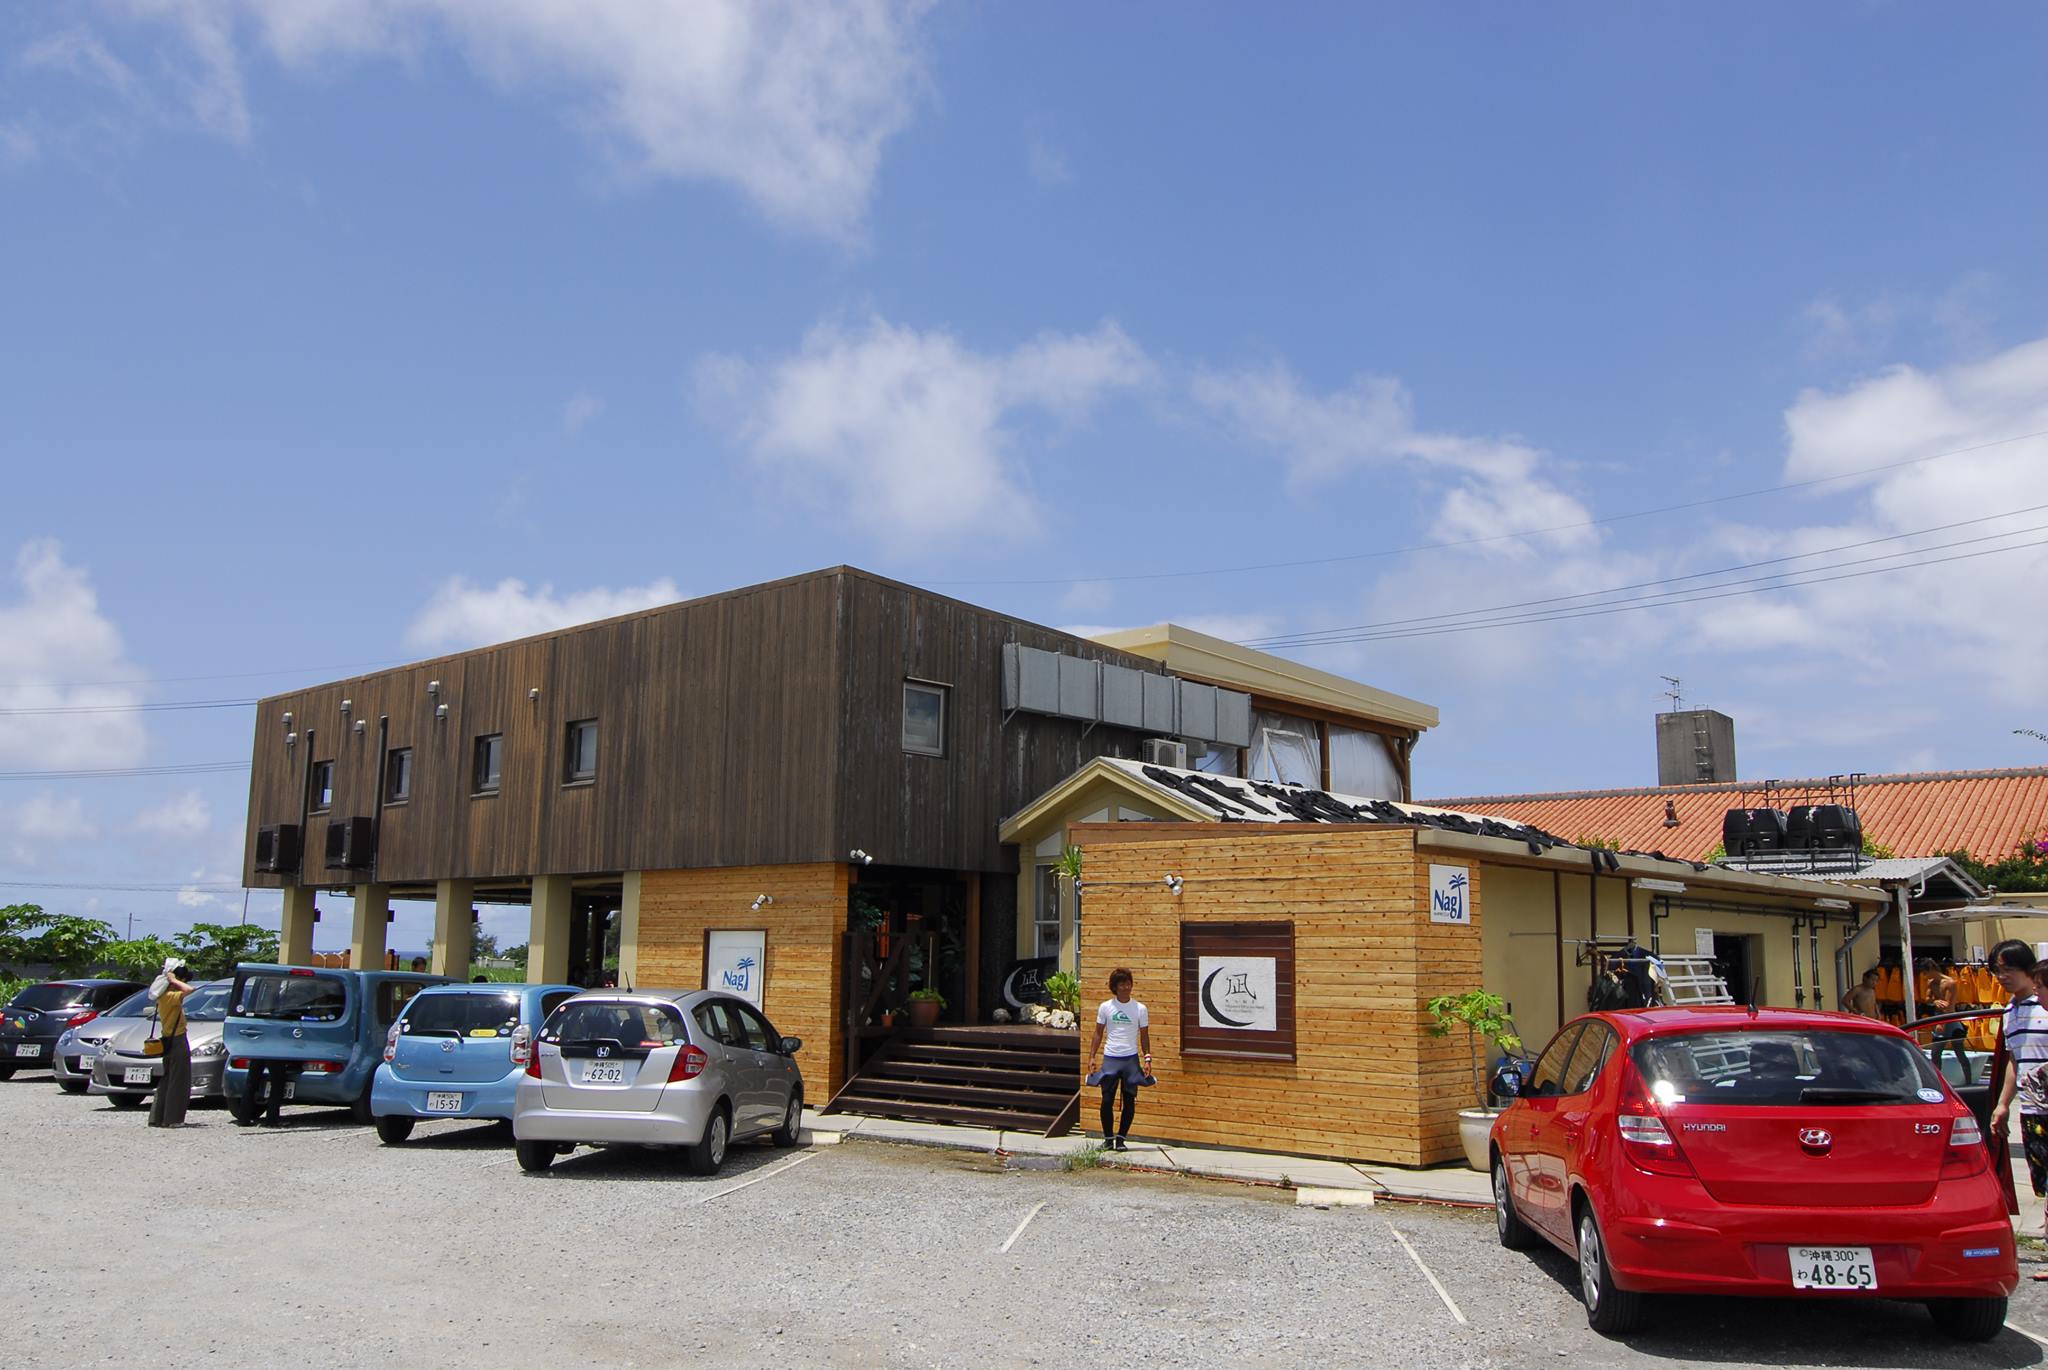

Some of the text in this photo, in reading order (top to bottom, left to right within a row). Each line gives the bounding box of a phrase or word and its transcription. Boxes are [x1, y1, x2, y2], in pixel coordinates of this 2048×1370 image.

[591, 1069, 621, 1081] 62-02
[435, 1100, 459, 1110] 15-57
[1683, 1124, 1726, 1132] HYUNDAI
[1811, 1264, 1871, 1285] 48-65
